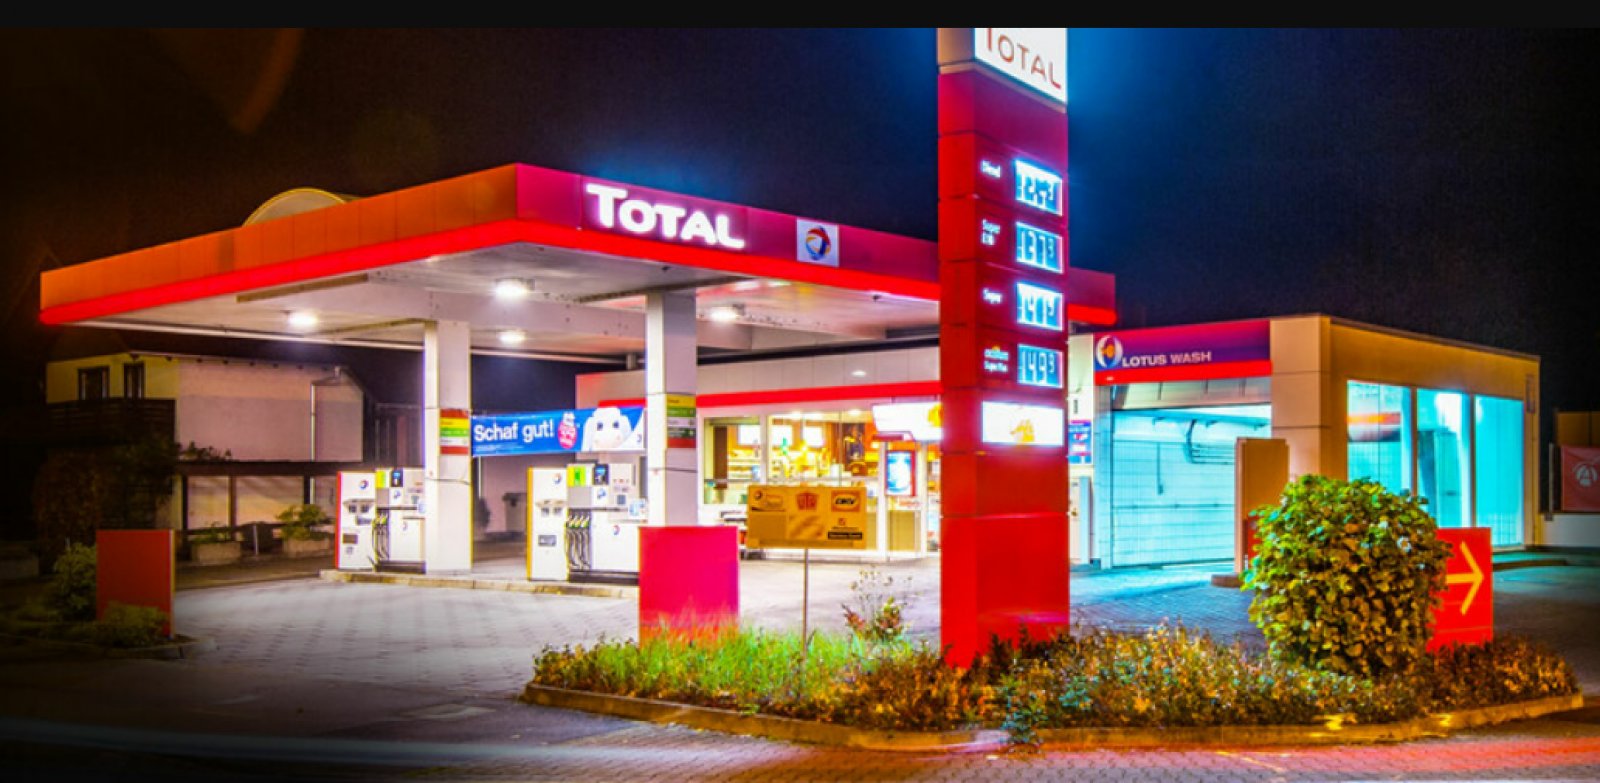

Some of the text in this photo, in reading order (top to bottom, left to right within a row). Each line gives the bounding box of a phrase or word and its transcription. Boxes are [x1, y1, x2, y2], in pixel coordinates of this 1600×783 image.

[586, 182, 745, 249] TOTAL
[1122, 351, 1212, 367] LOTUS WASH
[474, 421, 518, 442] Schaf
[522, 418, 554, 443] gut!
